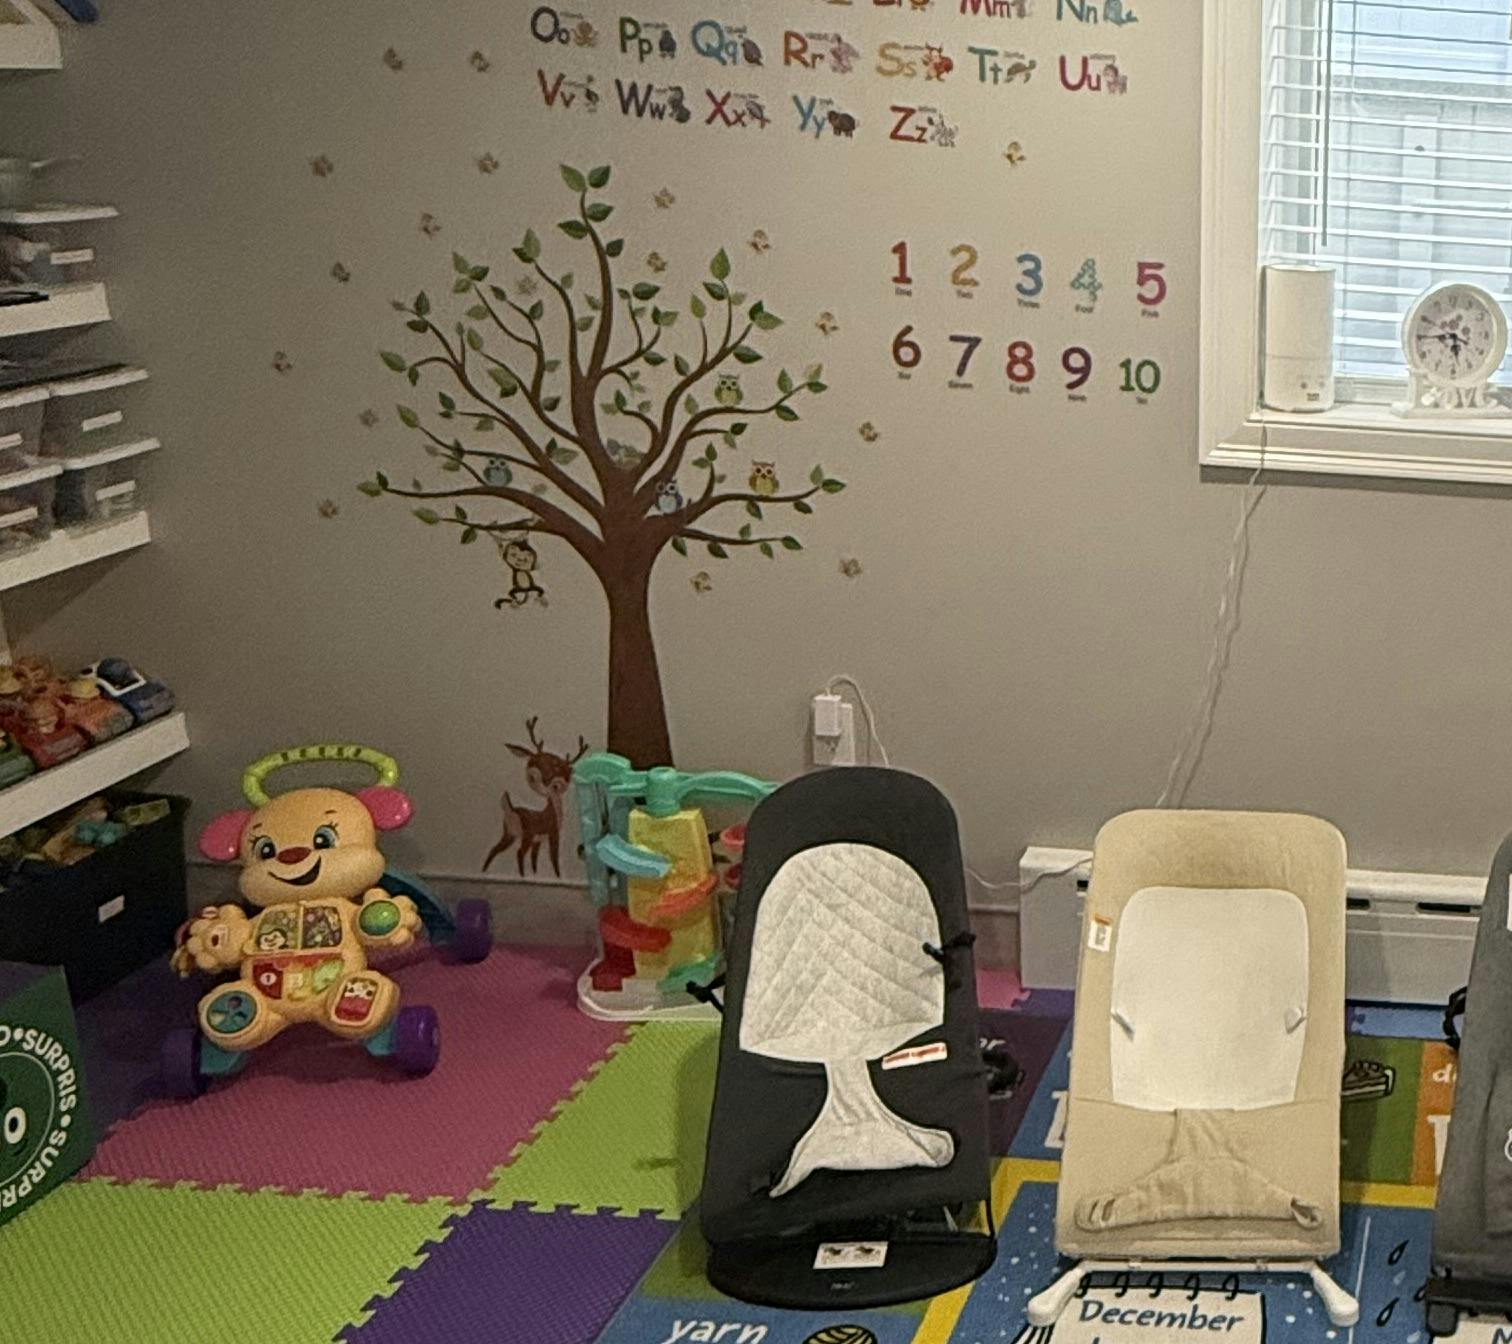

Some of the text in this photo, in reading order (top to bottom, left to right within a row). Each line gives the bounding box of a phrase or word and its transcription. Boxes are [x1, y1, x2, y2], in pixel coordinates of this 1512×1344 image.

[531, 7, 570, 45] Oo
[619, 16, 652, 62] Pp
[691, 20, 739, 66] Qq
[784, 30, 824, 68] Rr
[968, 46, 1003, 85] Tt
[1059, 55, 1101, 91] Uu
[537, 68, 927, 144] Vv Ww Xx Yy Zz
[891, 241, 1167, 305] 1 2 3 4 5
[892, 325, 1161, 393] 6 7 8 9 10
[1078, 1298, 1245, 1335] December
